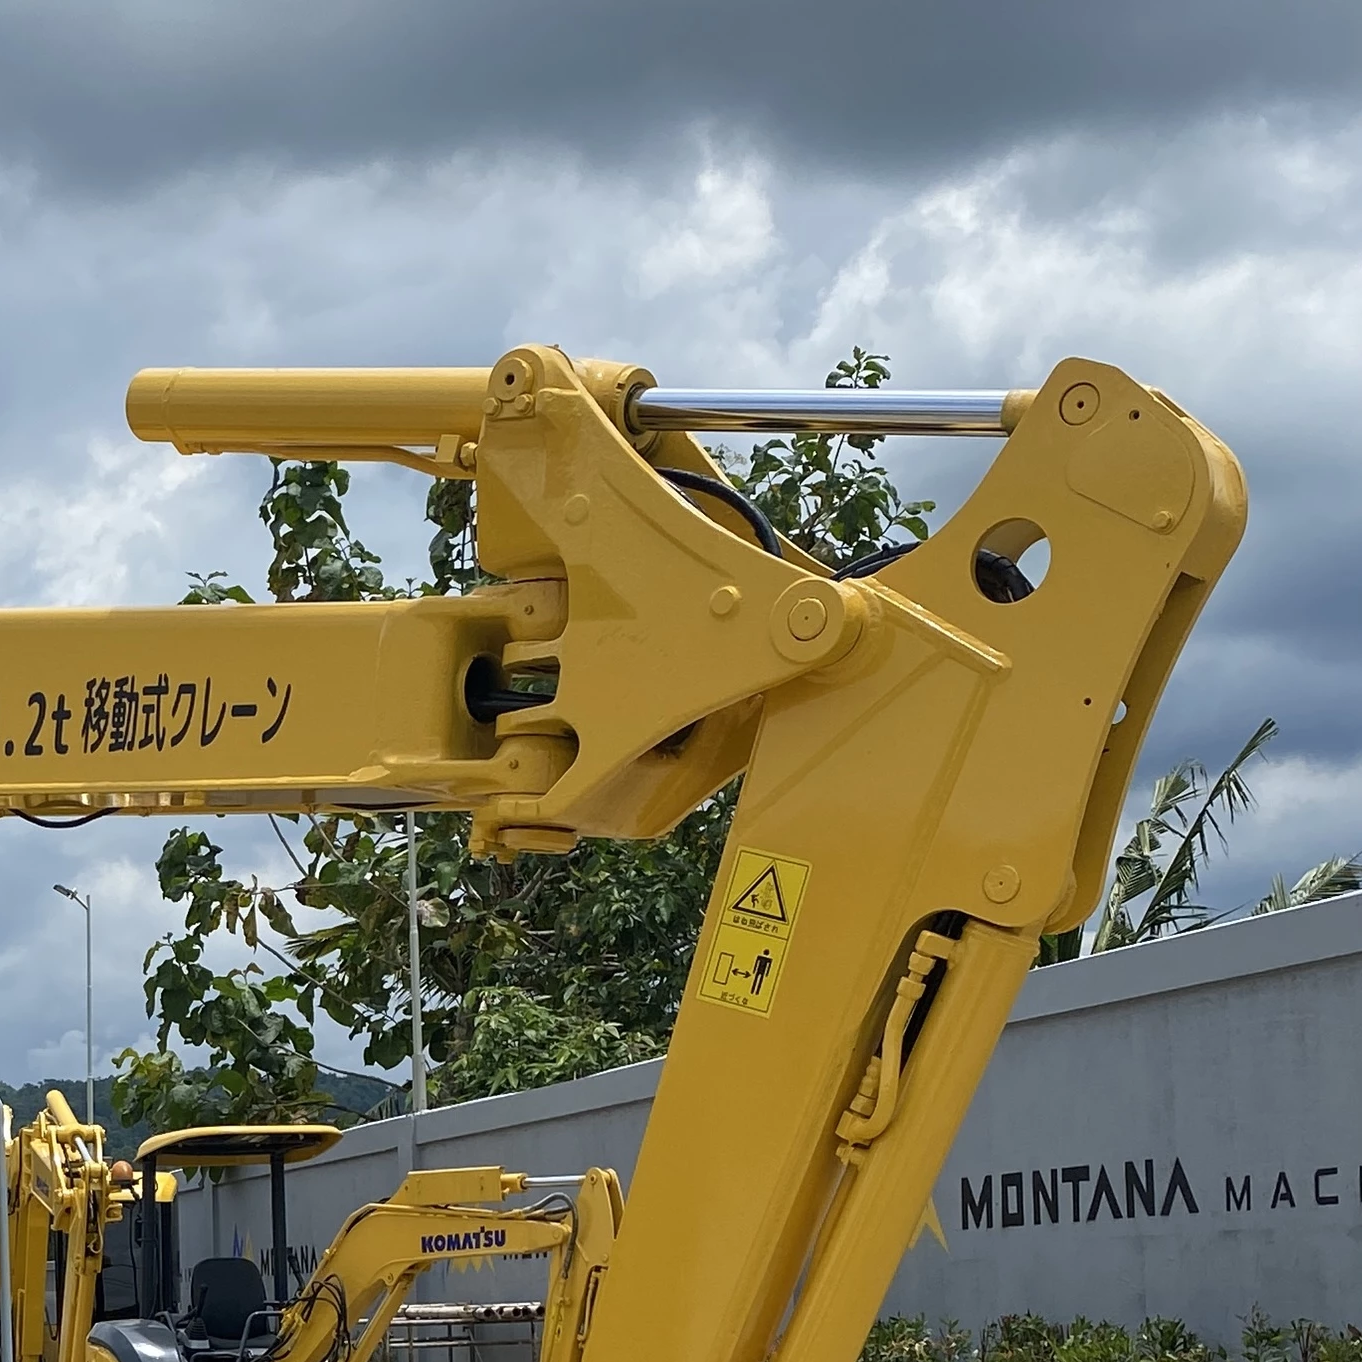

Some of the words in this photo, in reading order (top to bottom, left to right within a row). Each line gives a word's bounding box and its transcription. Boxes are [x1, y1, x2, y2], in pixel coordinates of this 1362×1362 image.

[961, 1156, 1200, 1230] MONTANA
[1225, 1165, 1362, 1213] MAC
[421, 1226, 506, 1254] KOMATSU
